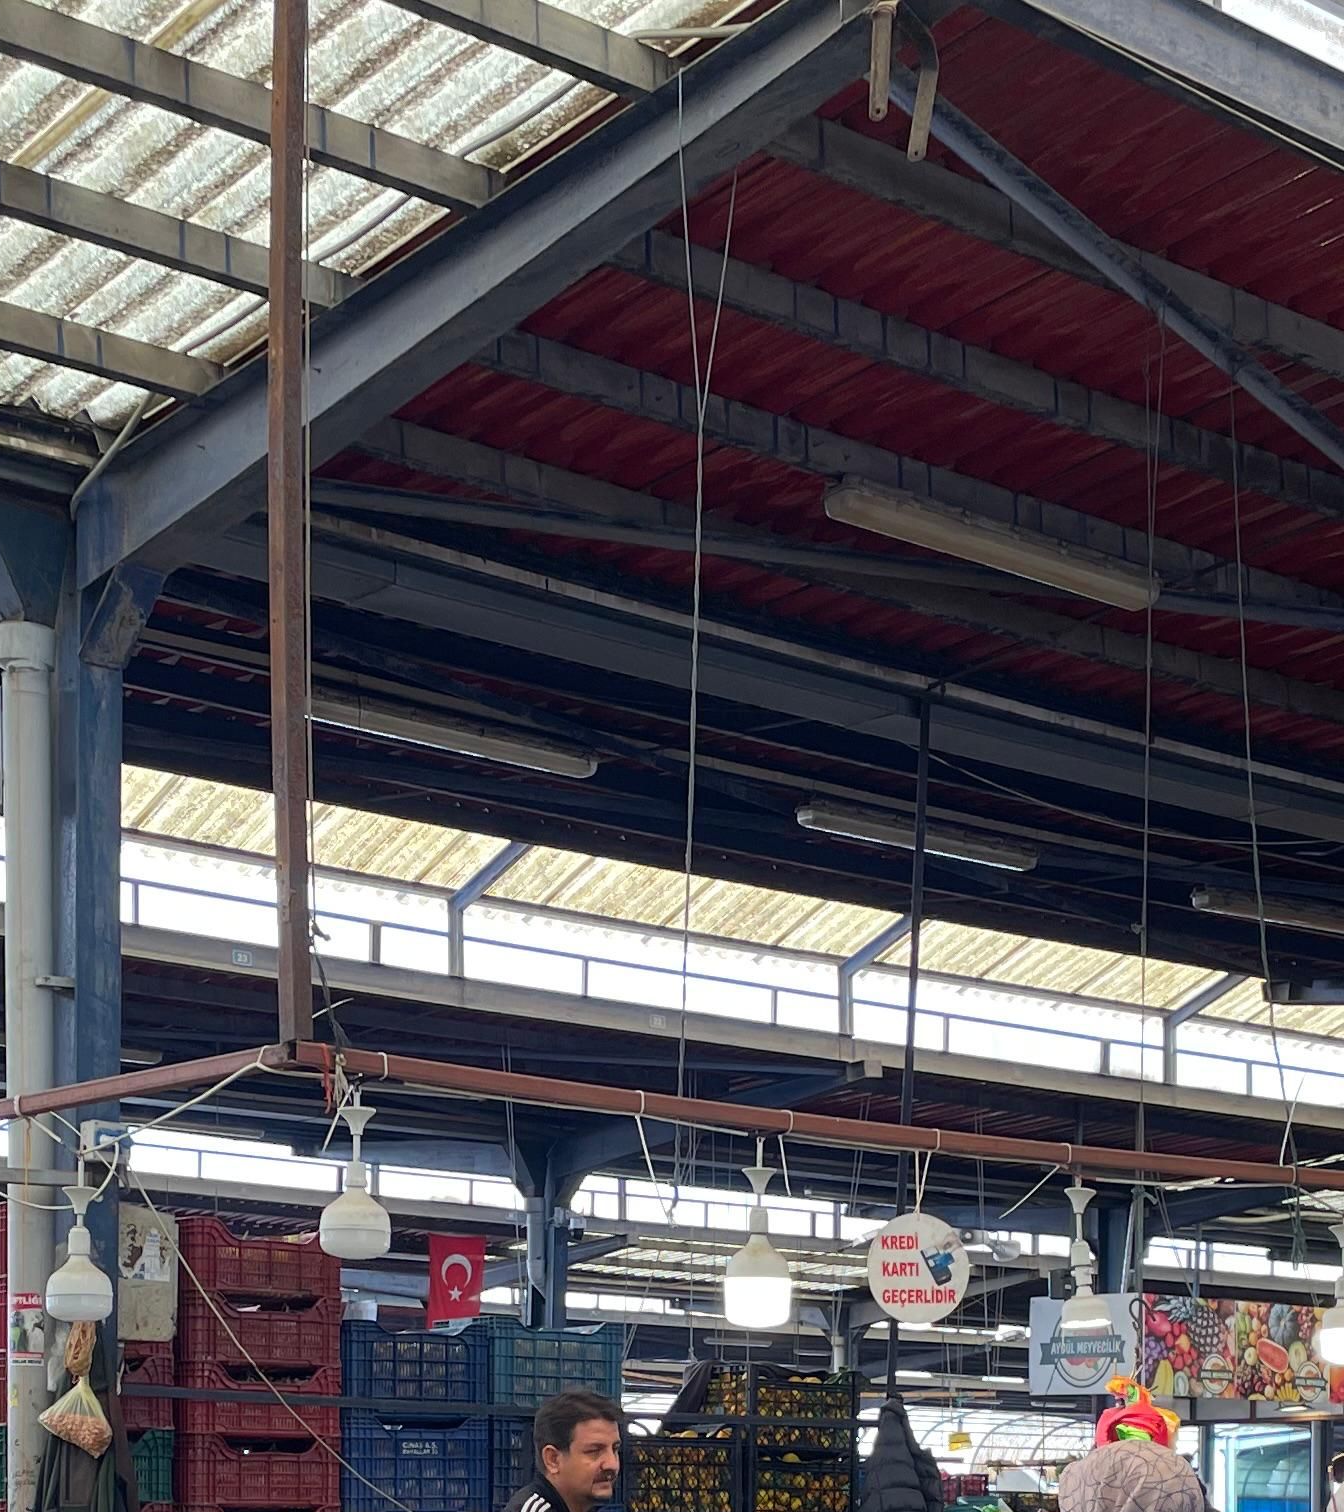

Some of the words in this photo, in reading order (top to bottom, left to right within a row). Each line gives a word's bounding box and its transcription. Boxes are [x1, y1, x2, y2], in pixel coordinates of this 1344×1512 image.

[881, 1232, 919, 1250] KREDİ
[882, 1262, 920, 1277] KARTI
[882, 1286, 957, 1307] GEÇERLİDİR
[1051, 1341, 1075, 1356] AYGÜL
[1076, 1337, 1122, 1354] MEYVECİLİK
